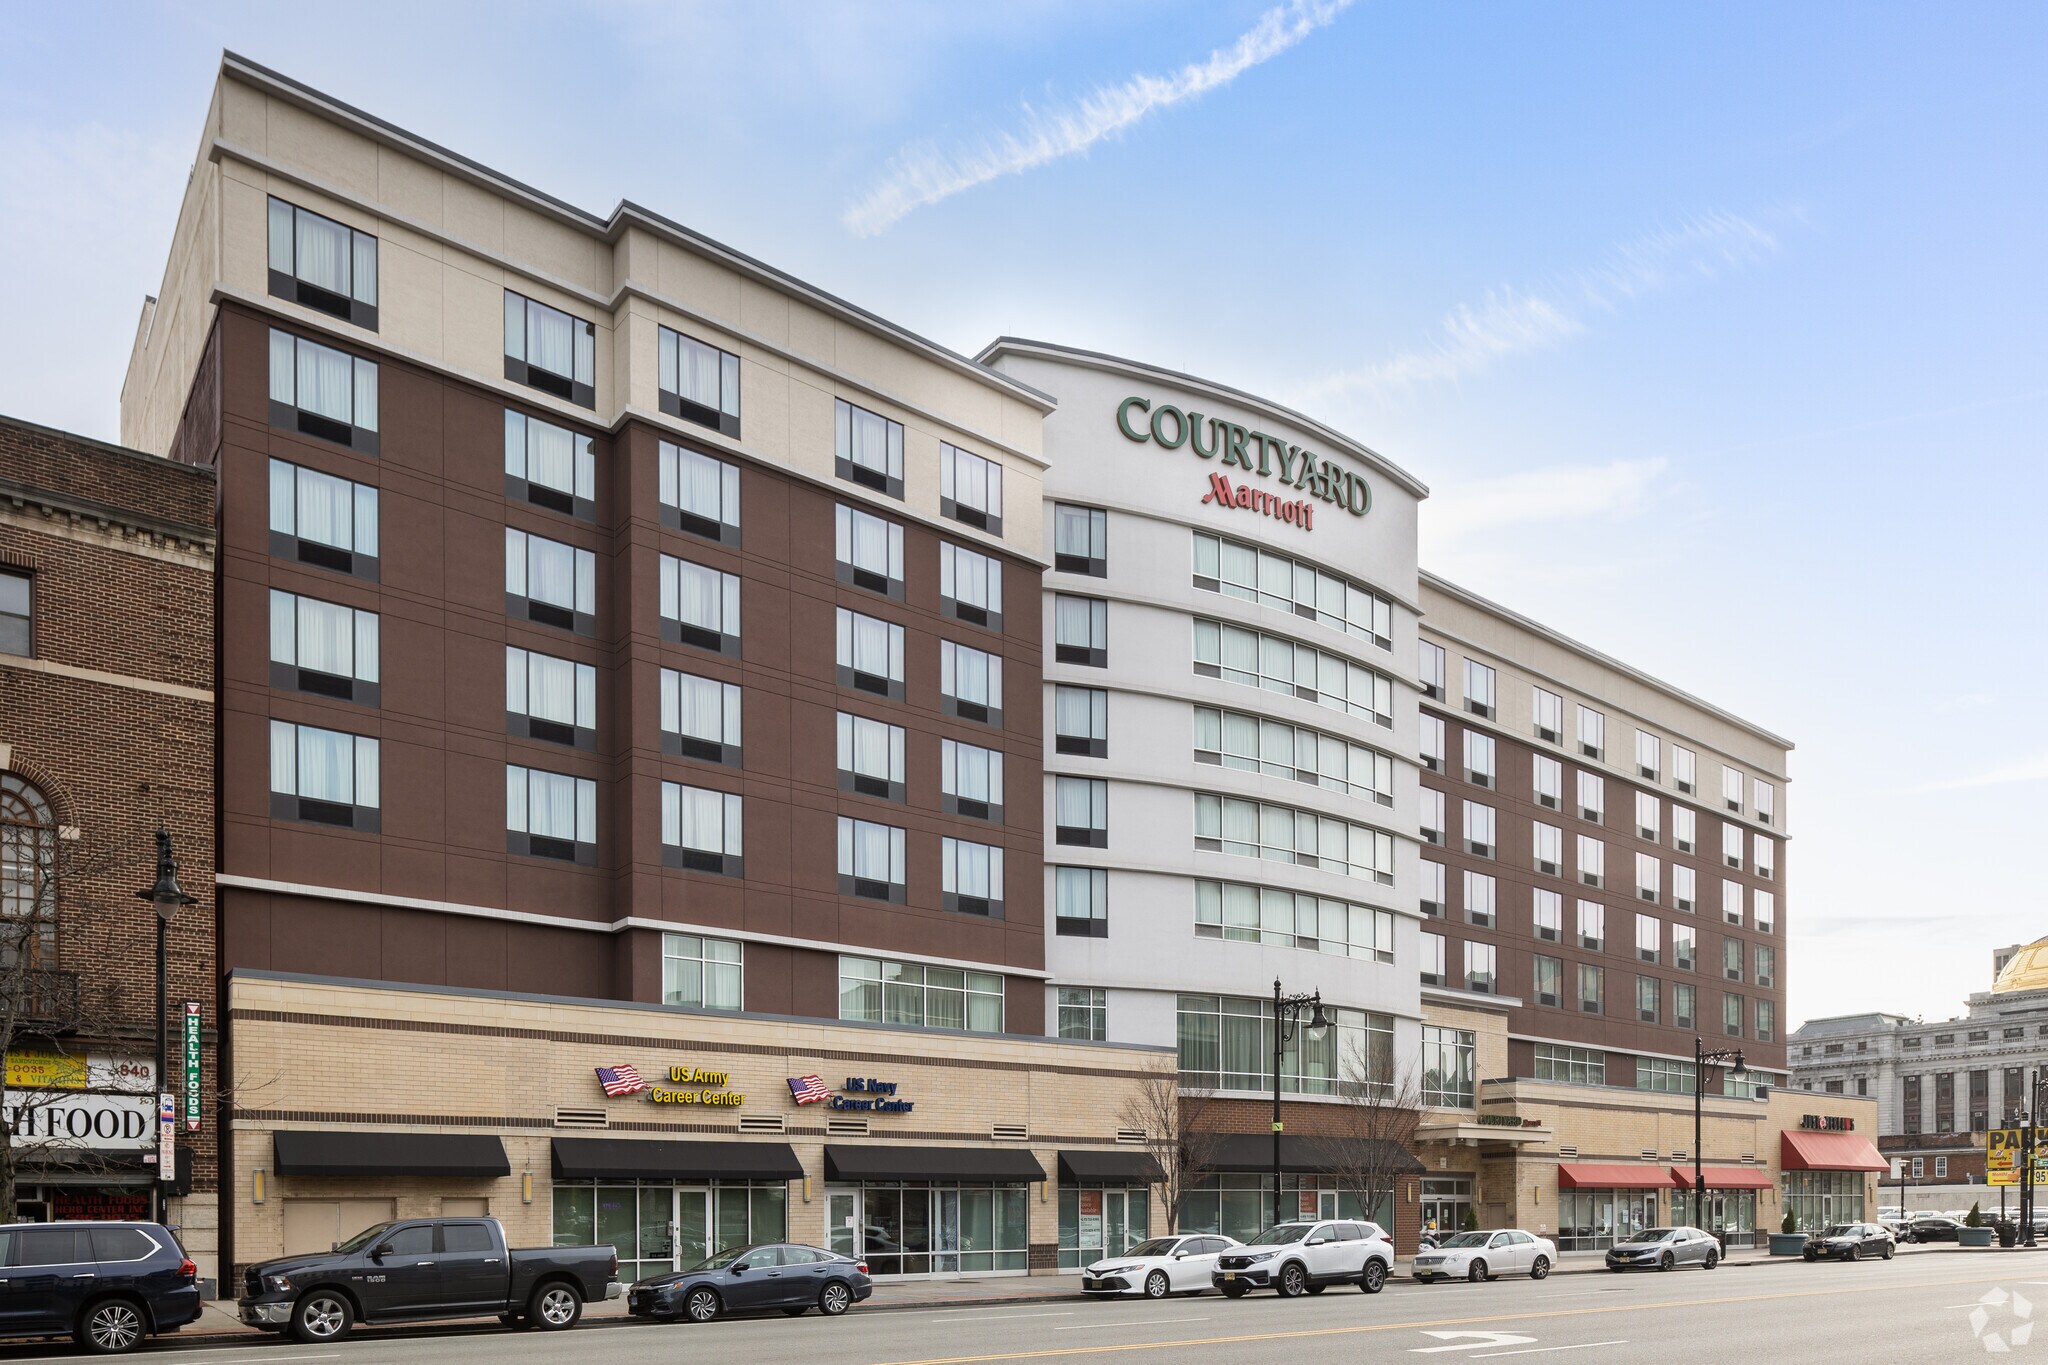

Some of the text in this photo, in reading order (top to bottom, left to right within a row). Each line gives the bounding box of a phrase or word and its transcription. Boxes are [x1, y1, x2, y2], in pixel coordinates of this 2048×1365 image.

[1117, 396, 1373, 516] COURTYARD
[1201, 472, 1314, 531] Marriott
[119, 1064, 150, 1078] 840
[187, 1018, 199, 1114] HEALTH FOODS
[669, 1066, 729, 1087] US Army
[846, 1077, 897, 1096] US Navy
[652, 1087, 746, 1106] Career Center
[833, 1095, 914, 1112] Career Center
[46, 1106, 146, 1139] FOOD
[55, 1205, 83, 1214] HERB
[88, 1205, 124, 1214] CENTER
